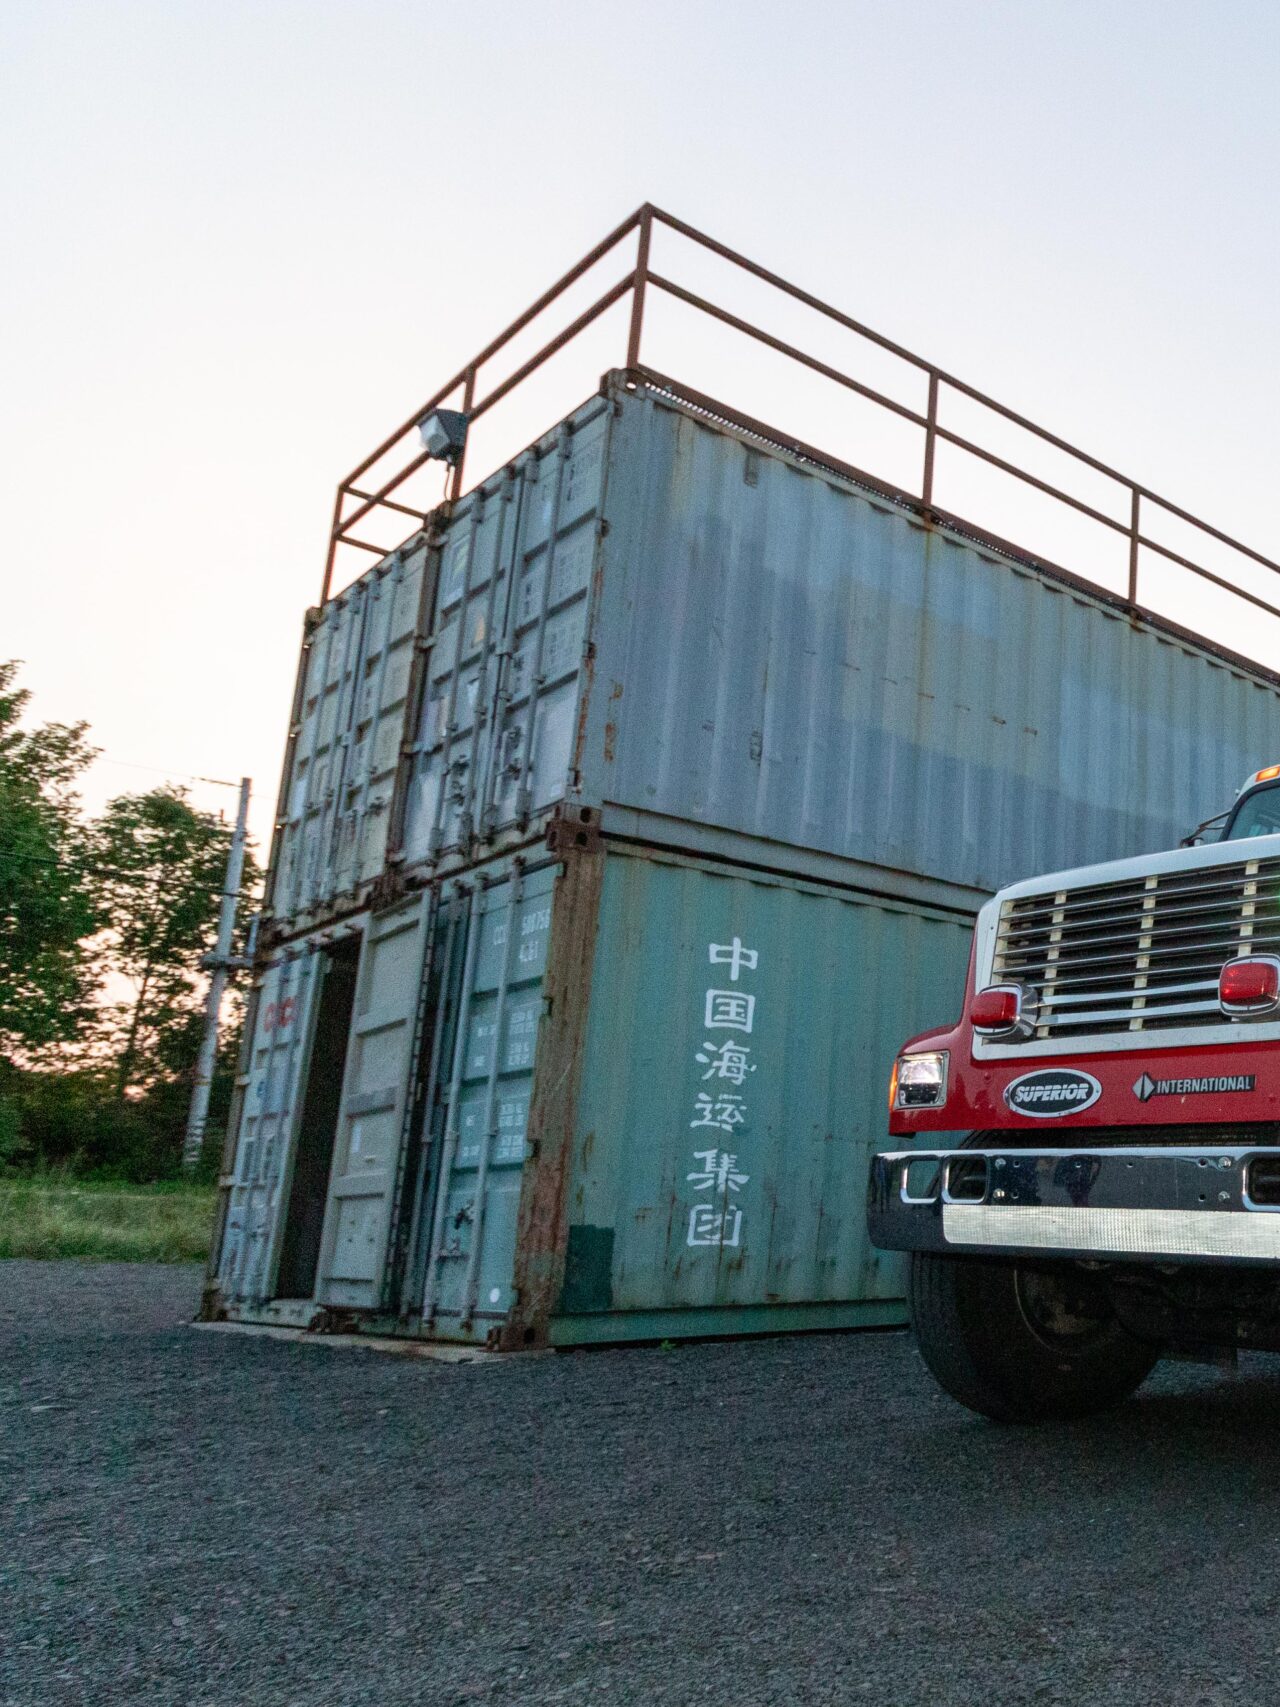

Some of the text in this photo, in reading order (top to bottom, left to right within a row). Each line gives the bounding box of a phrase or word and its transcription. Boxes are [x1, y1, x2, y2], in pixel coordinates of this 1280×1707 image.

[686, 936, 759, 1247] 中国海运集团
[1013, 1082, 1090, 1103] SUPERIOR
[1156, 1075, 1251, 1094] INTERNATIONAL
